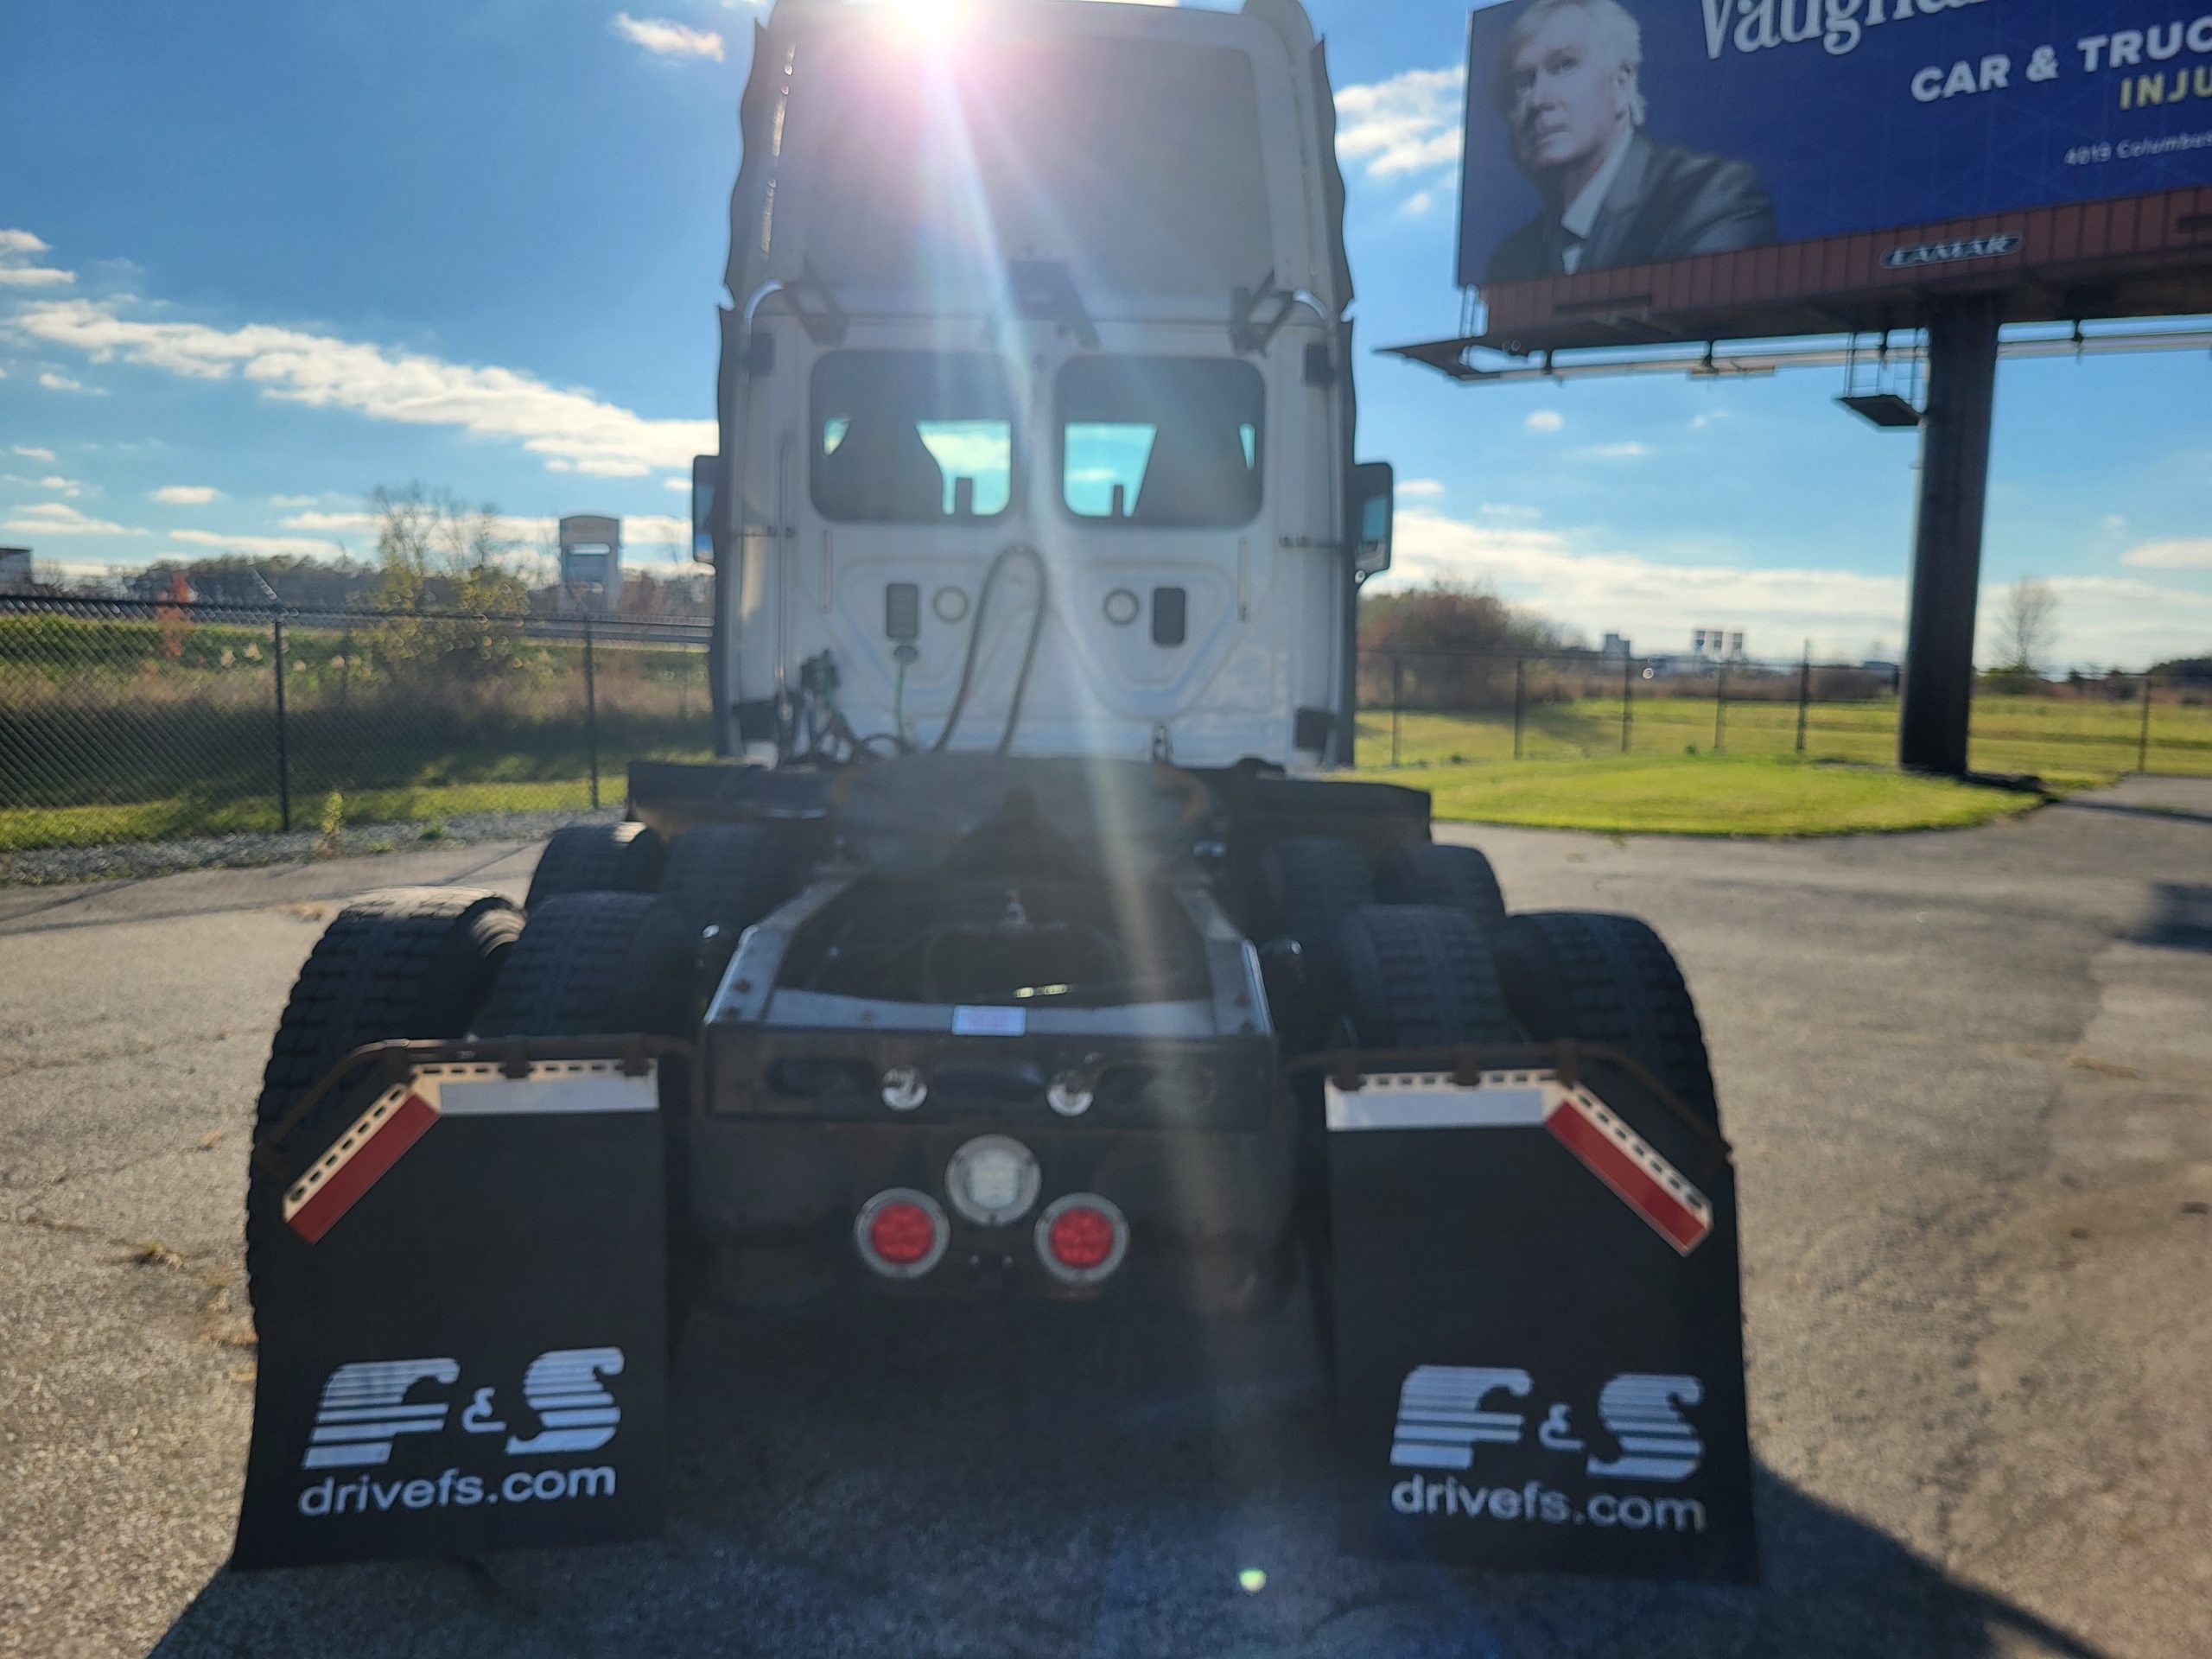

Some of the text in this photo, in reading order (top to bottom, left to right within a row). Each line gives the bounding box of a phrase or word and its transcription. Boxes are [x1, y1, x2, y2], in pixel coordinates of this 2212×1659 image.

[1700, 0, 1987, 60] Vaug
[1911, 16, 2212, 102] CAR & TRUC
[2120, 65, 2212, 111] INJU
[299, 1466, 617, 1516] drivefs.com
[1390, 1473, 1707, 1533] drivefs.com
